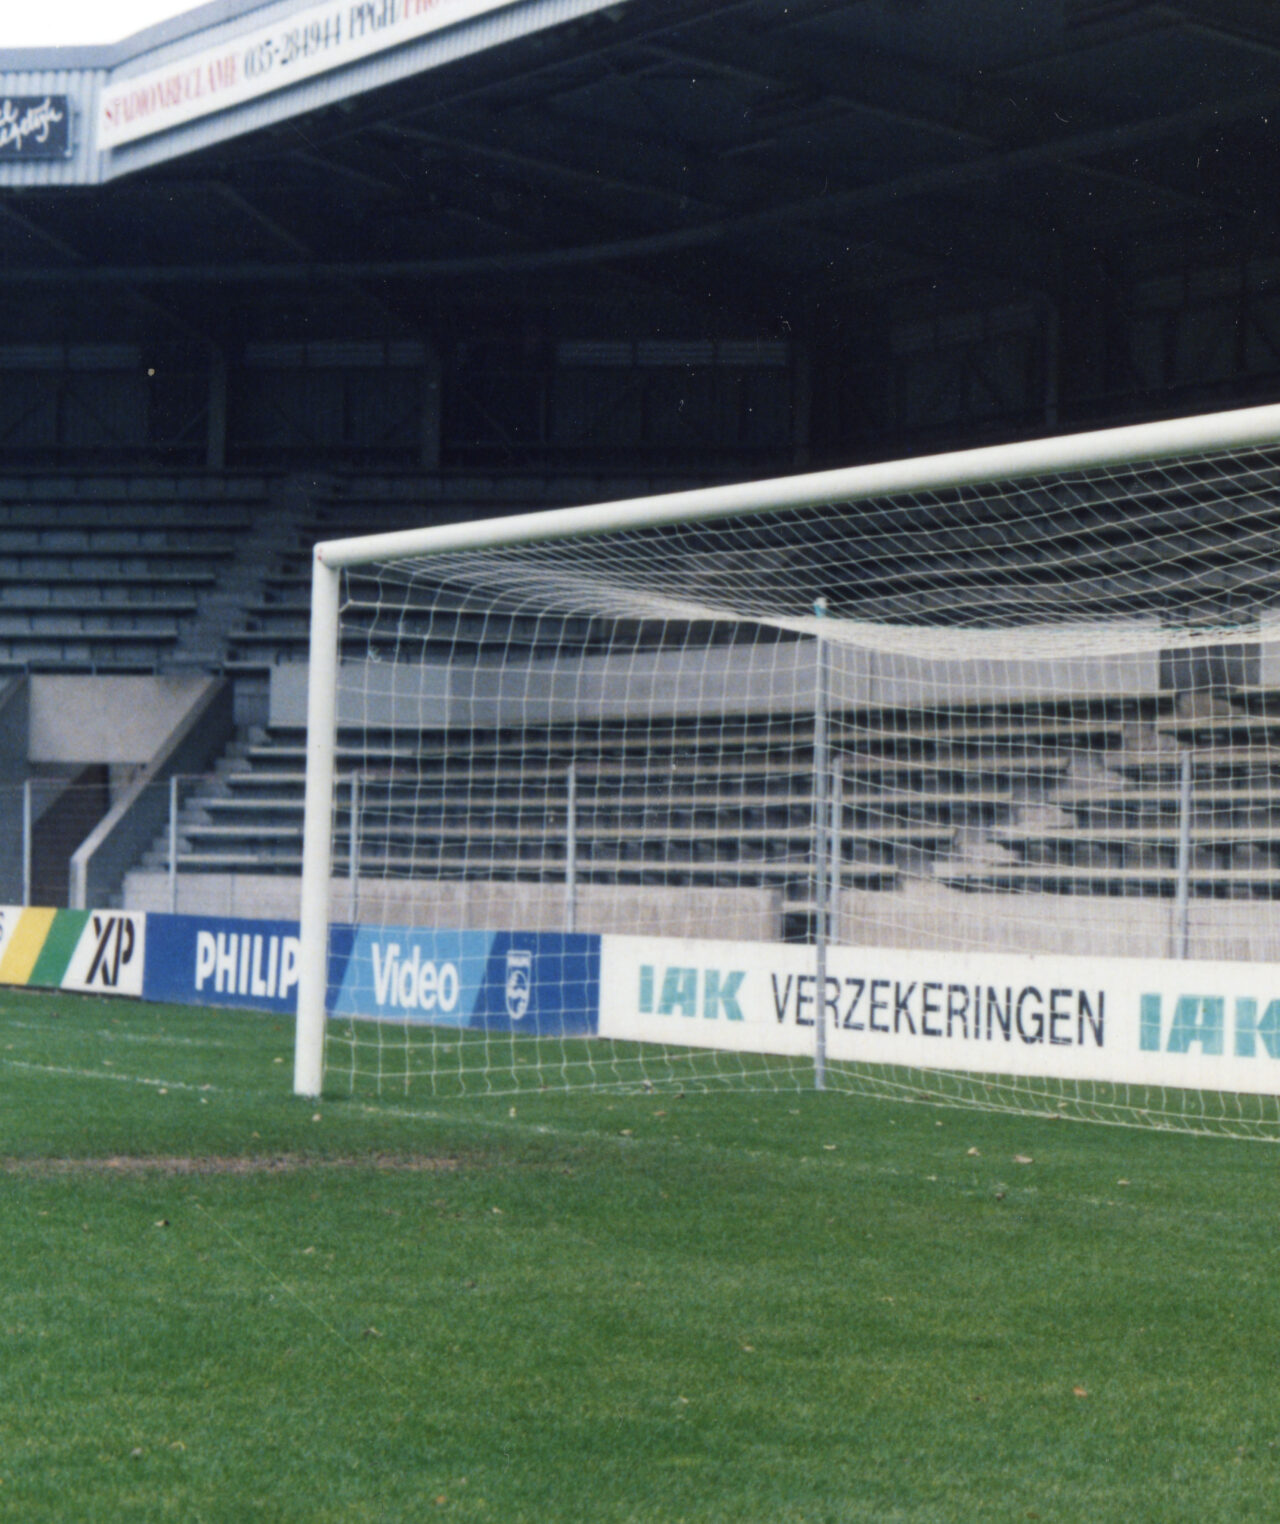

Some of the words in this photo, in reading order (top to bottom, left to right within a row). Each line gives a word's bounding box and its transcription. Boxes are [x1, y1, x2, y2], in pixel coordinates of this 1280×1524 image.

[85, 916, 135, 987] XP
[195, 930, 300, 999] PHILIP
[371, 942, 459, 1012] Video
[638, 964, 745, 1021] IAK
[771, 972, 1105, 1048] VERZEKERINGEN
